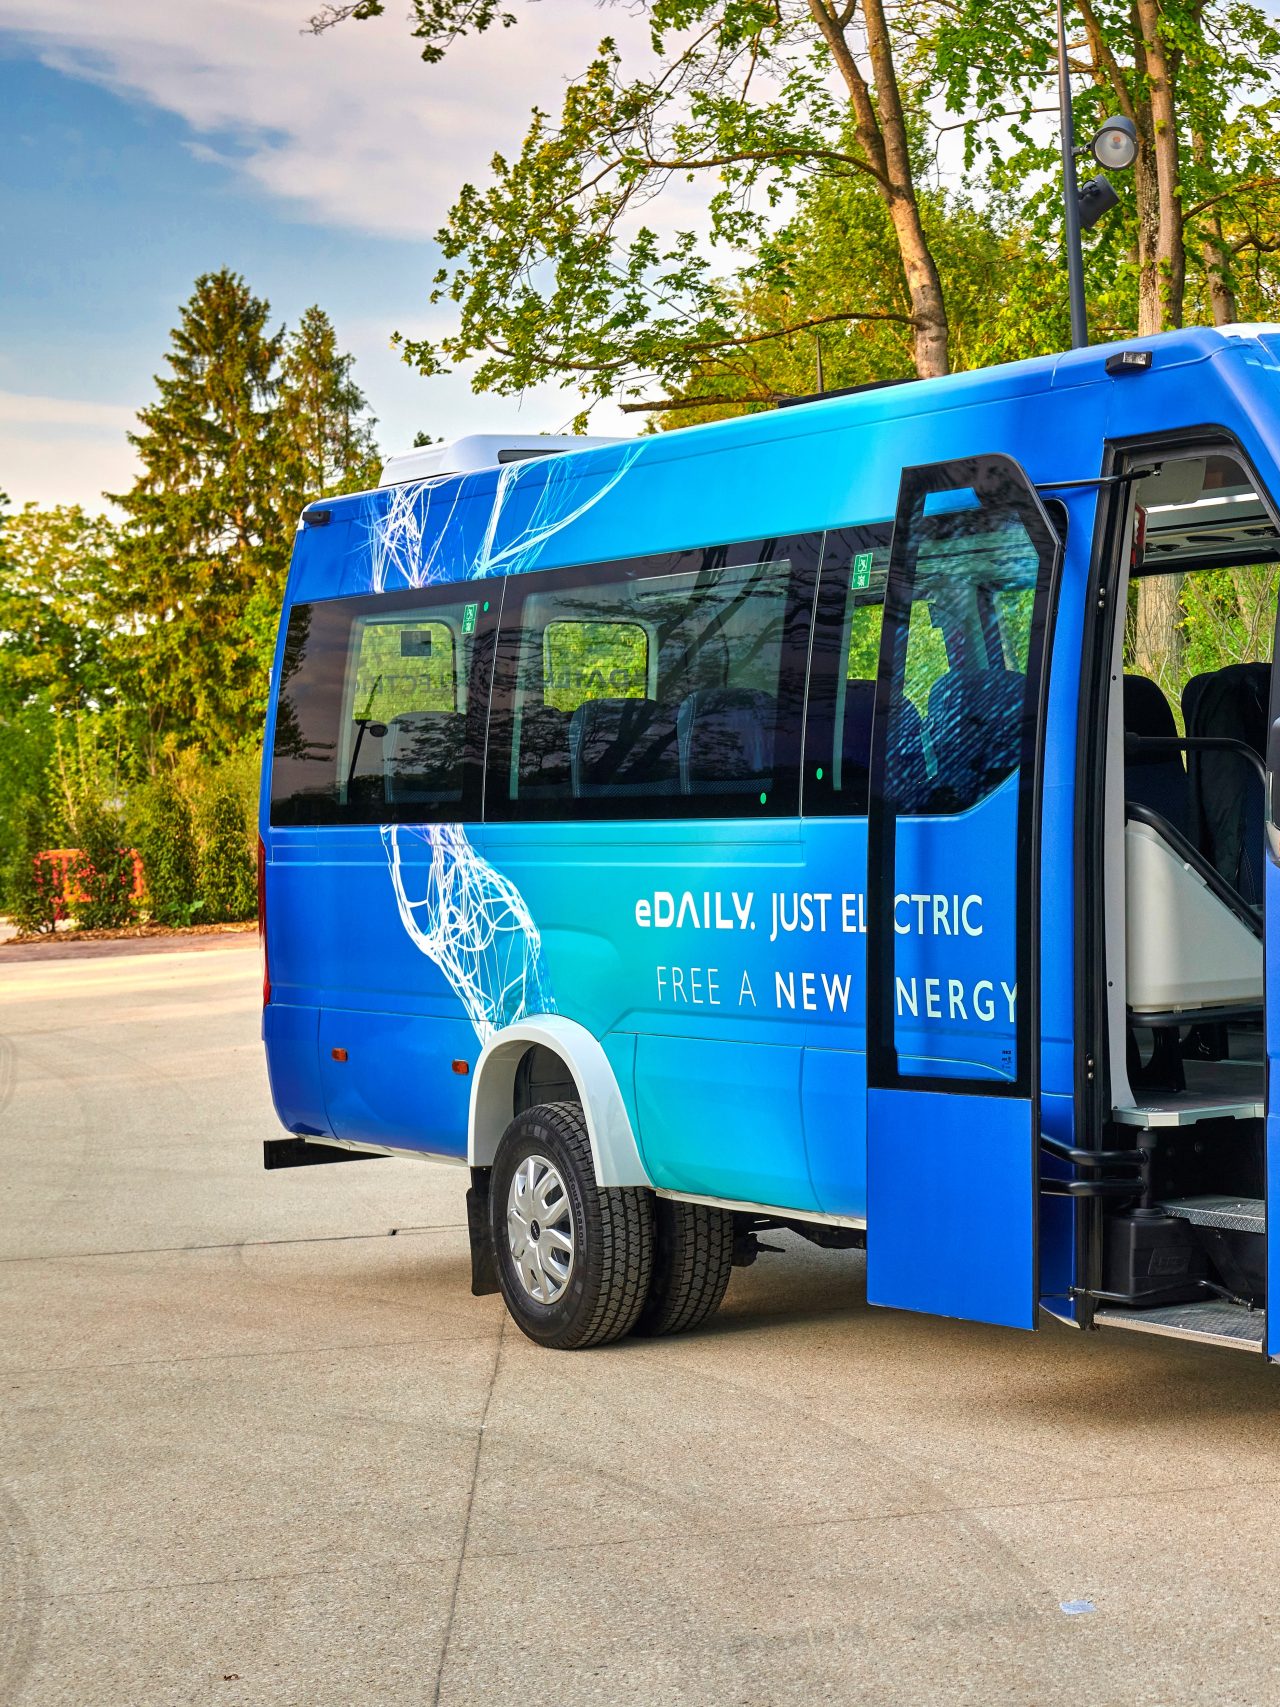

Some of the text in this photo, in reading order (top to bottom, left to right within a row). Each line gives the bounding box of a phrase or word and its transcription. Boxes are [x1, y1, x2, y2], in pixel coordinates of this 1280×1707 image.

[769, 892, 832, 941] JUST
[842, 894, 983, 937] ELCTRIC
[656, 966, 1017, 1024] FREE A NEW NERGY
